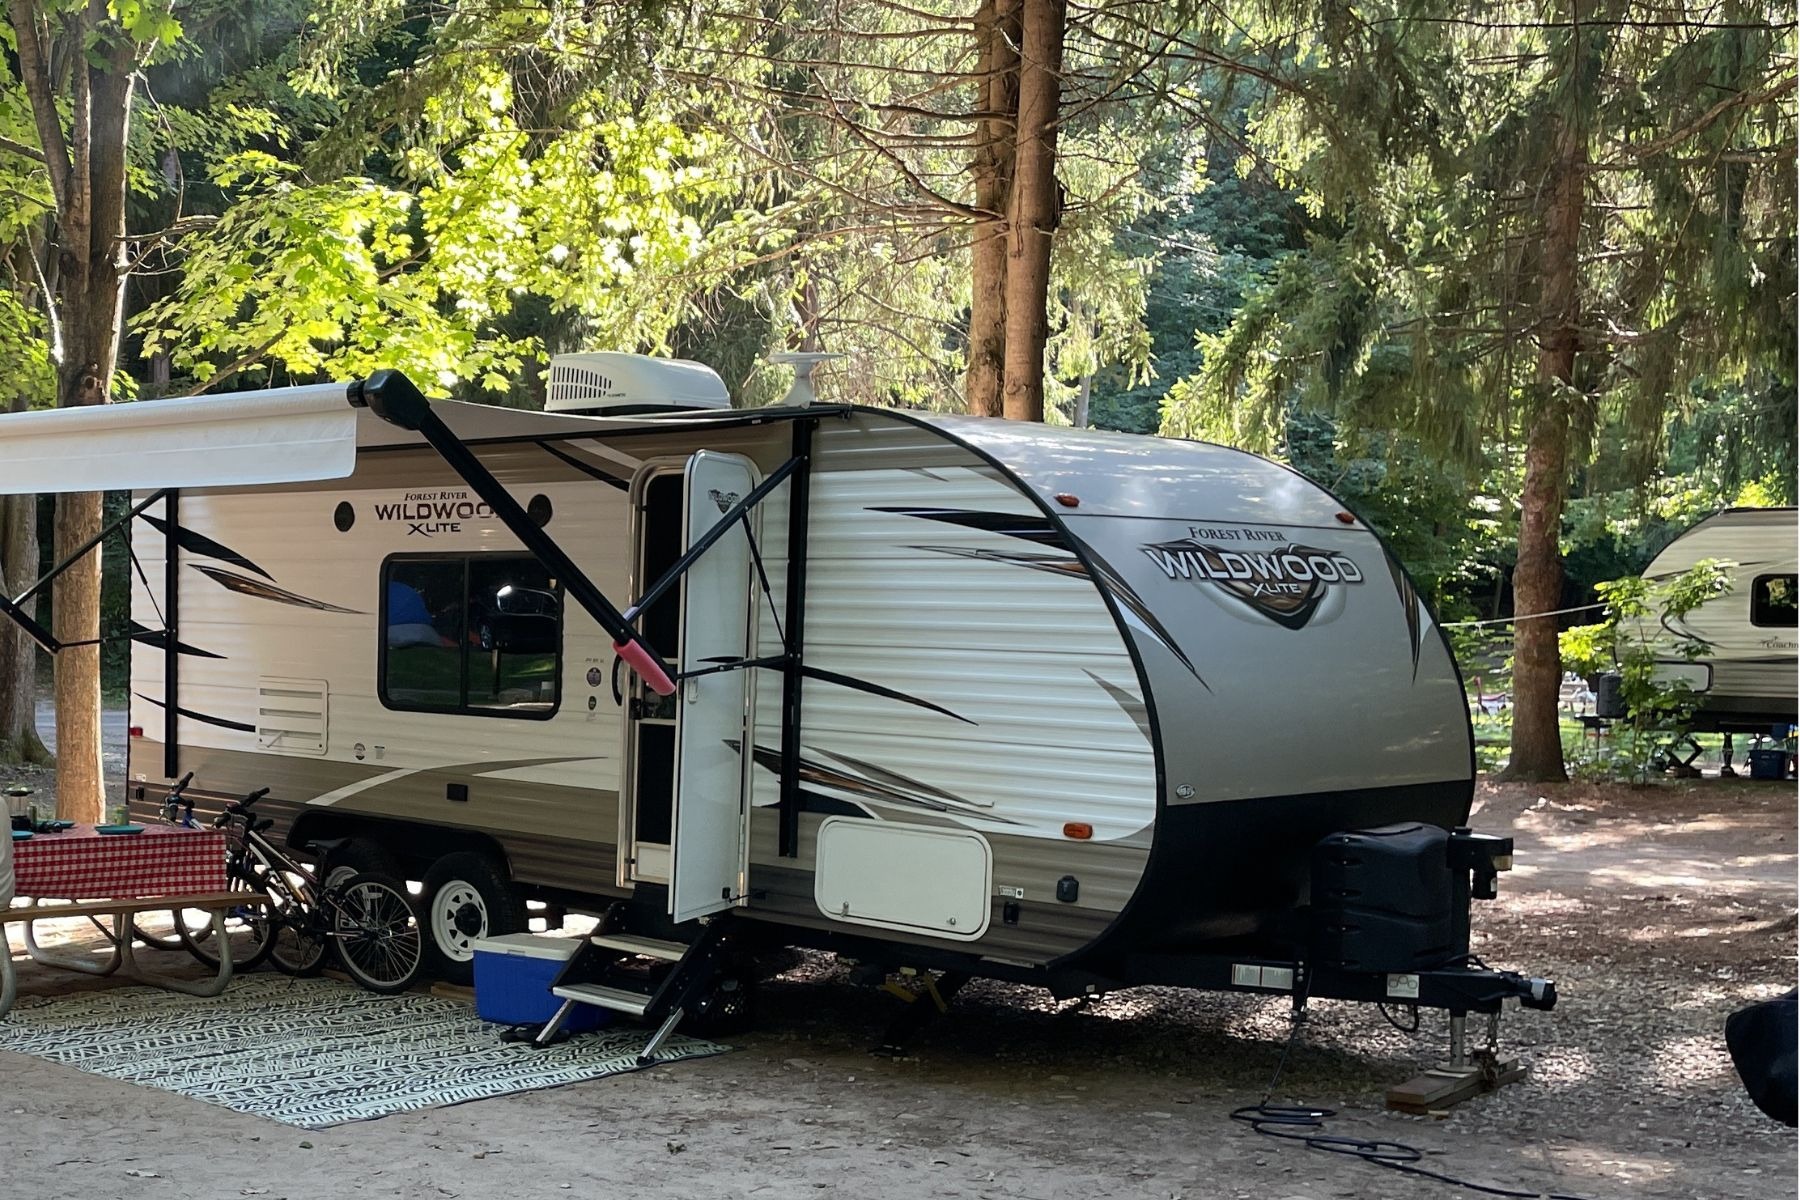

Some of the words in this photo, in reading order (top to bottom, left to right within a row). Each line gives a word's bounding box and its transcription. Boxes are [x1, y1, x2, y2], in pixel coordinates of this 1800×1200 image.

[404, 492, 438, 501] FOREST
[440, 491, 468, 500] RIVER
[375, 502, 500, 520] WILDWOO
[407, 522, 461, 538] XLITE
[1188, 526, 1242, 542] FOREST
[1243, 528, 1288, 542] RIVER
[1144, 549, 1363, 583] WILDWOOD
[1250, 582, 1302, 597] XLITE
